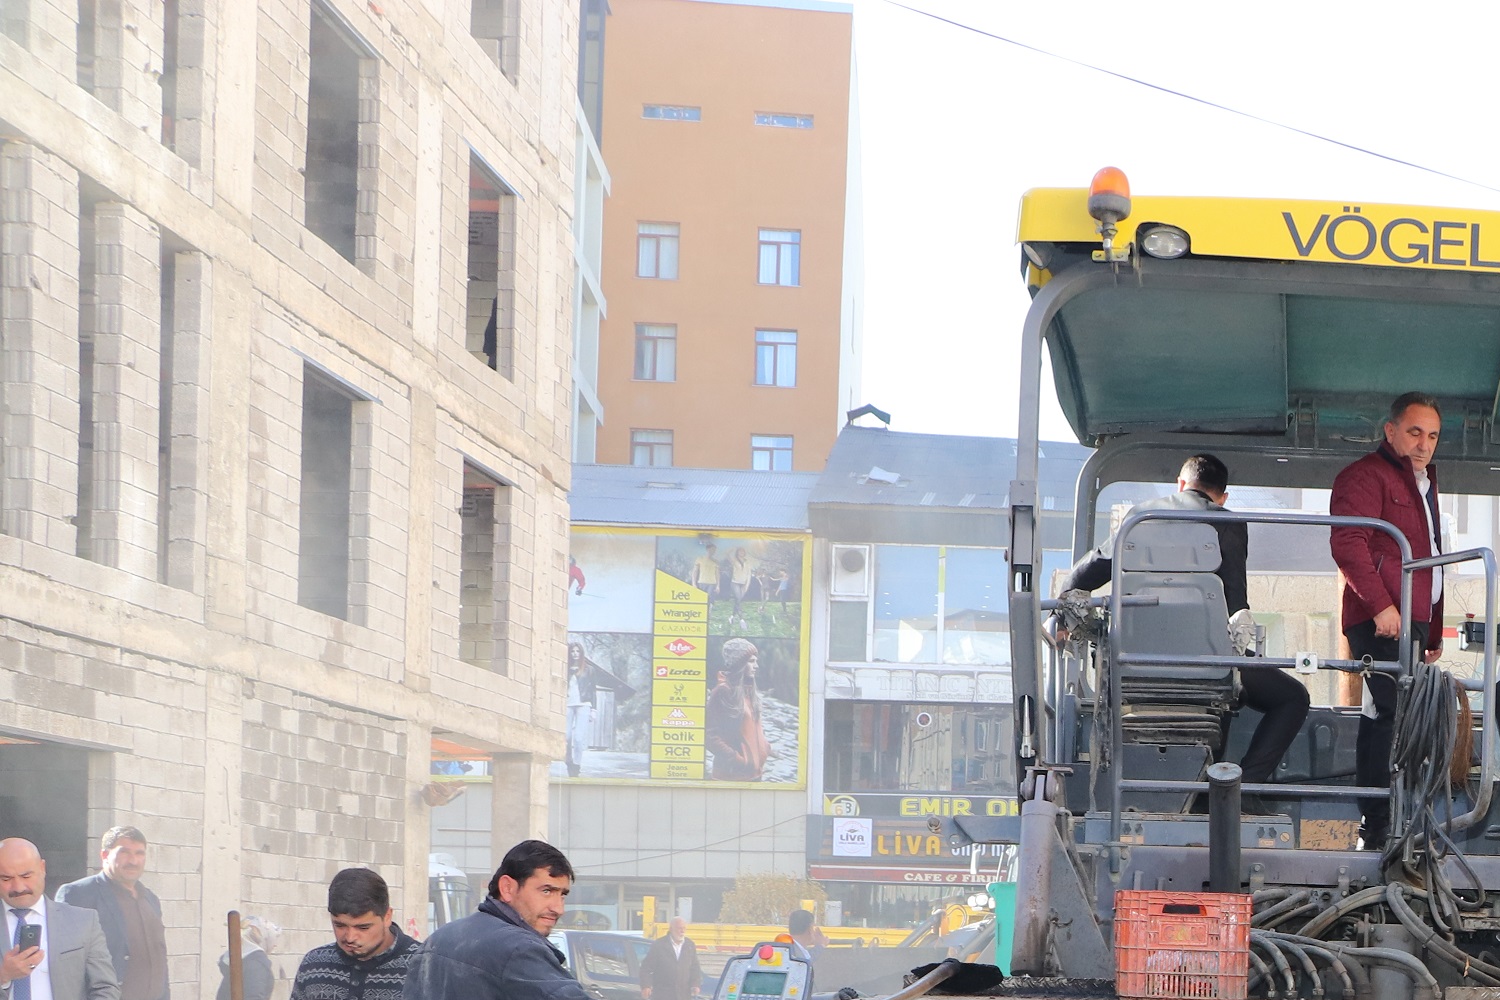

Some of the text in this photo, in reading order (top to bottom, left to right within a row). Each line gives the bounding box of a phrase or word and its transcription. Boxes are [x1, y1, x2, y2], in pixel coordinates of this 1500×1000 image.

[671, 590, 690, 600] Lee
[662, 609, 702, 621] Wrangler
[661, 624, 702, 633] CAZADOR
[663, 731, 695, 741] batik
[840, 833, 864, 841] LİVA
[877, 831, 941, 855] LİVA
[904, 872, 942, 882] CAFE
[945, 873, 958, 882] &
